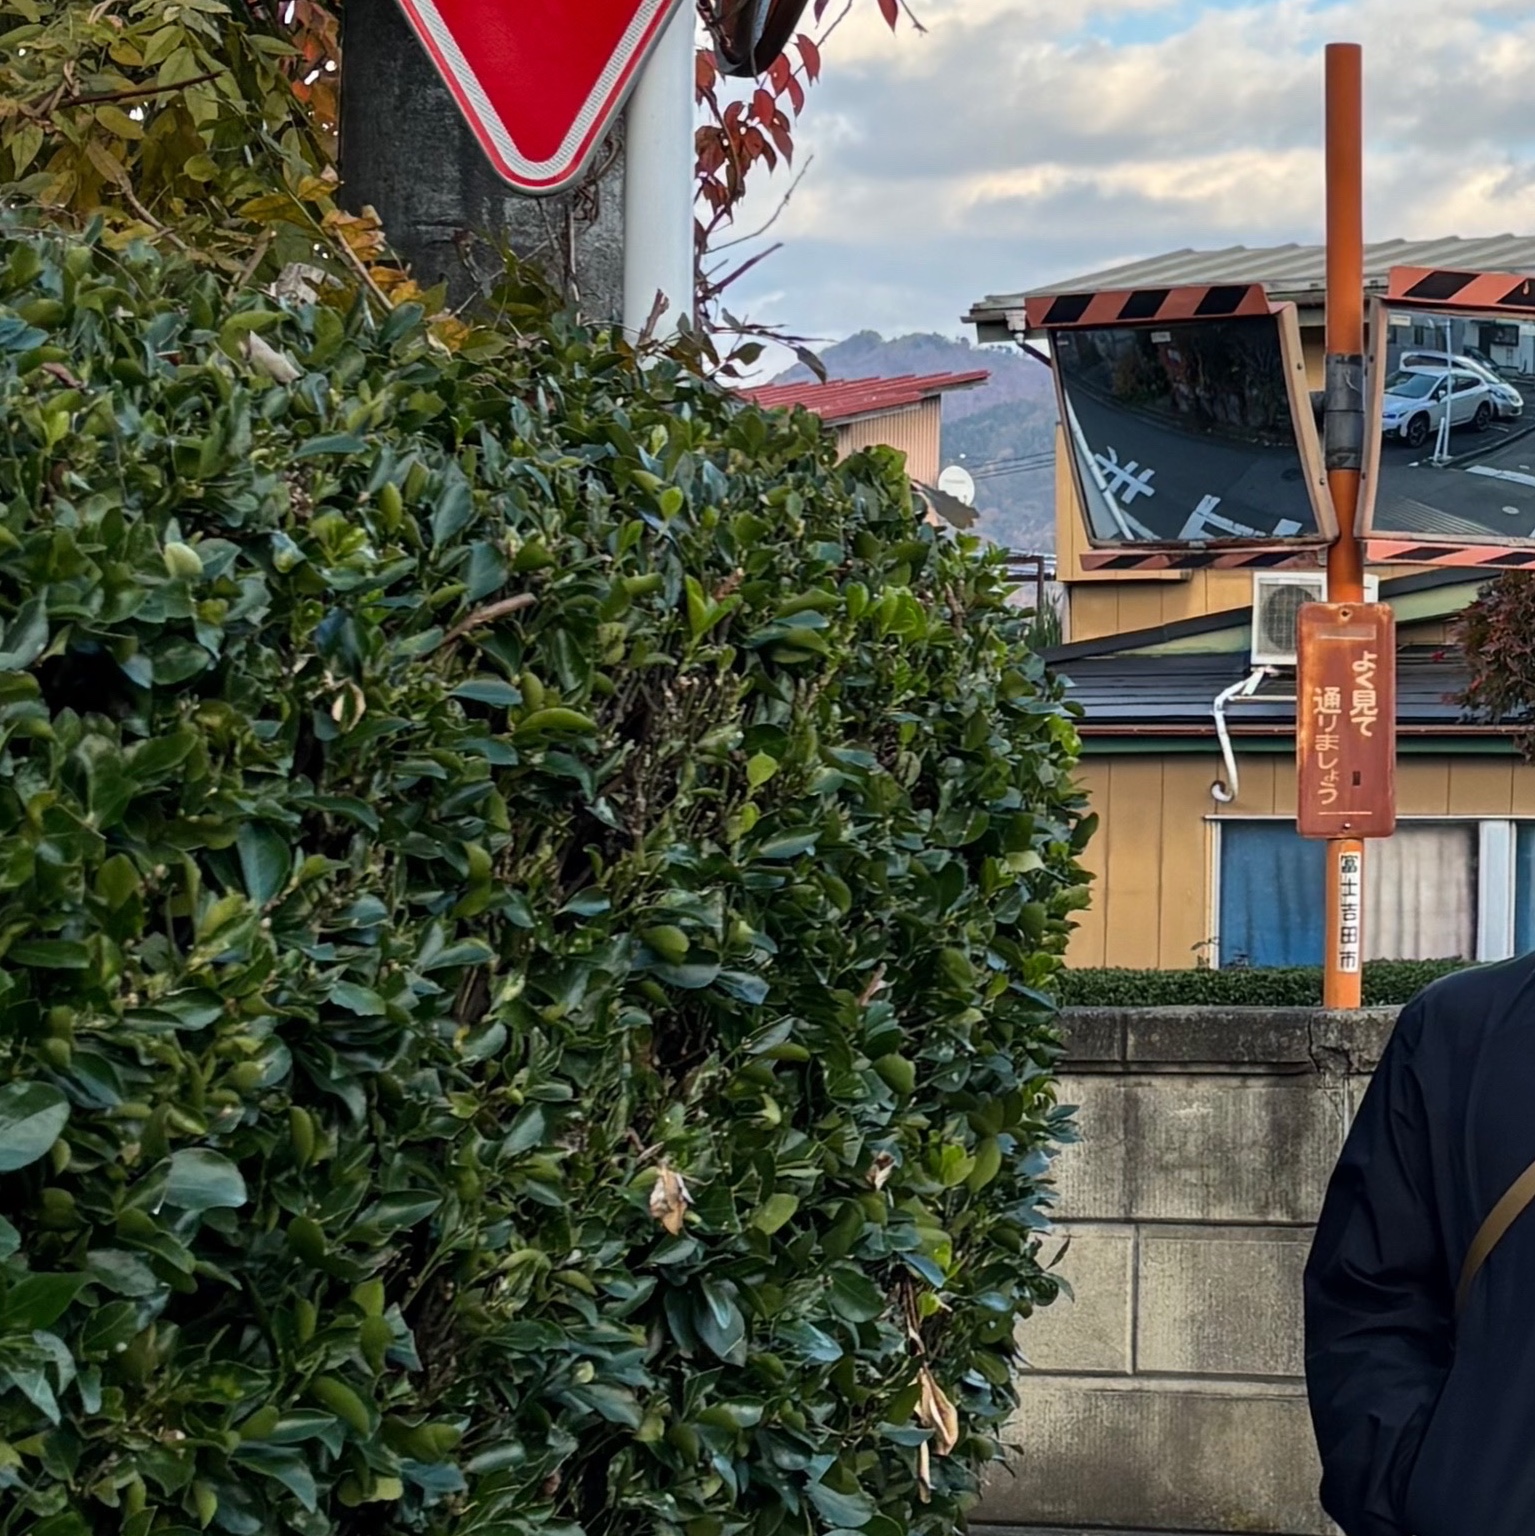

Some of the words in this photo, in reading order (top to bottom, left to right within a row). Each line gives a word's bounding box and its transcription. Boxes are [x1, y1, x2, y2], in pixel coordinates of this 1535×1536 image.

[1312, 686, 1342, 806] 通りましょう
[1349, 650, 1379, 738] よく見て
[1339, 853, 1359, 971] 富士吉田市
